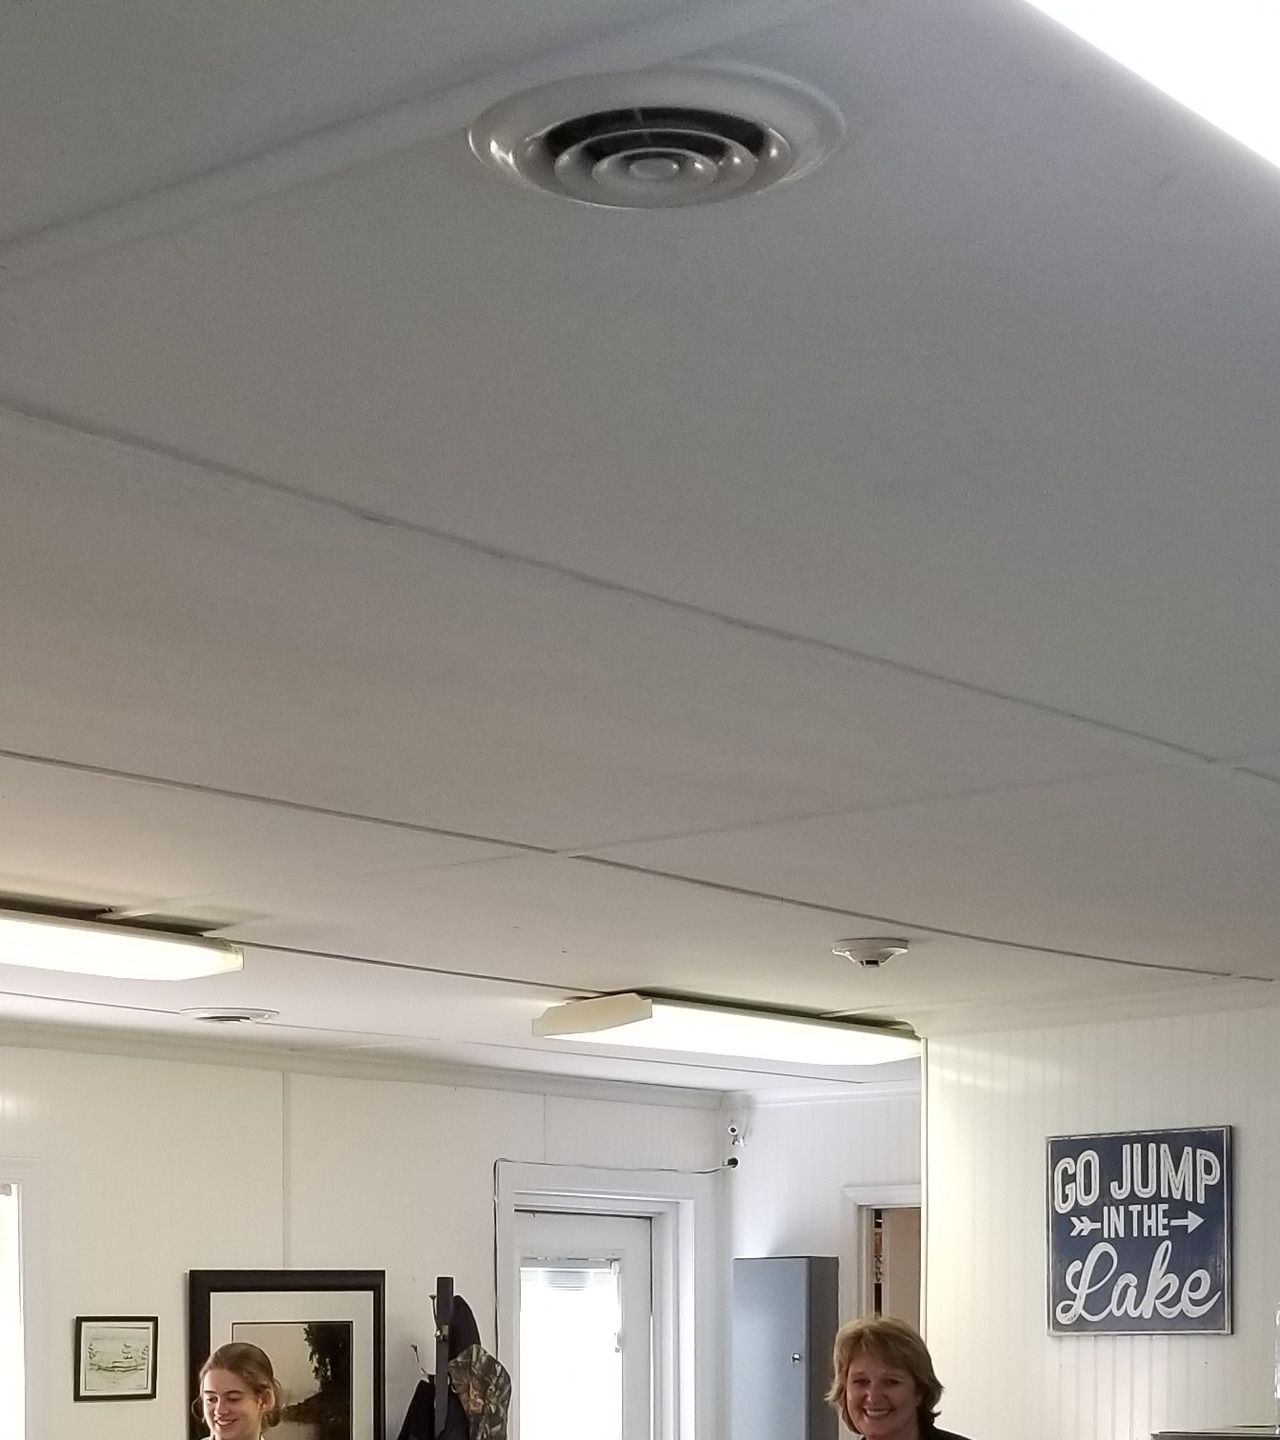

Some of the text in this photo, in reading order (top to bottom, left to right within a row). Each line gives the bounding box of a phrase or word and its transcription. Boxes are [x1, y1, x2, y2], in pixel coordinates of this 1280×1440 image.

[1054, 1143, 1221, 1214] GO JUMP
[1103, 1203, 1170, 1239] IN THE
[1055, 1240, 1222, 1325] Lake
